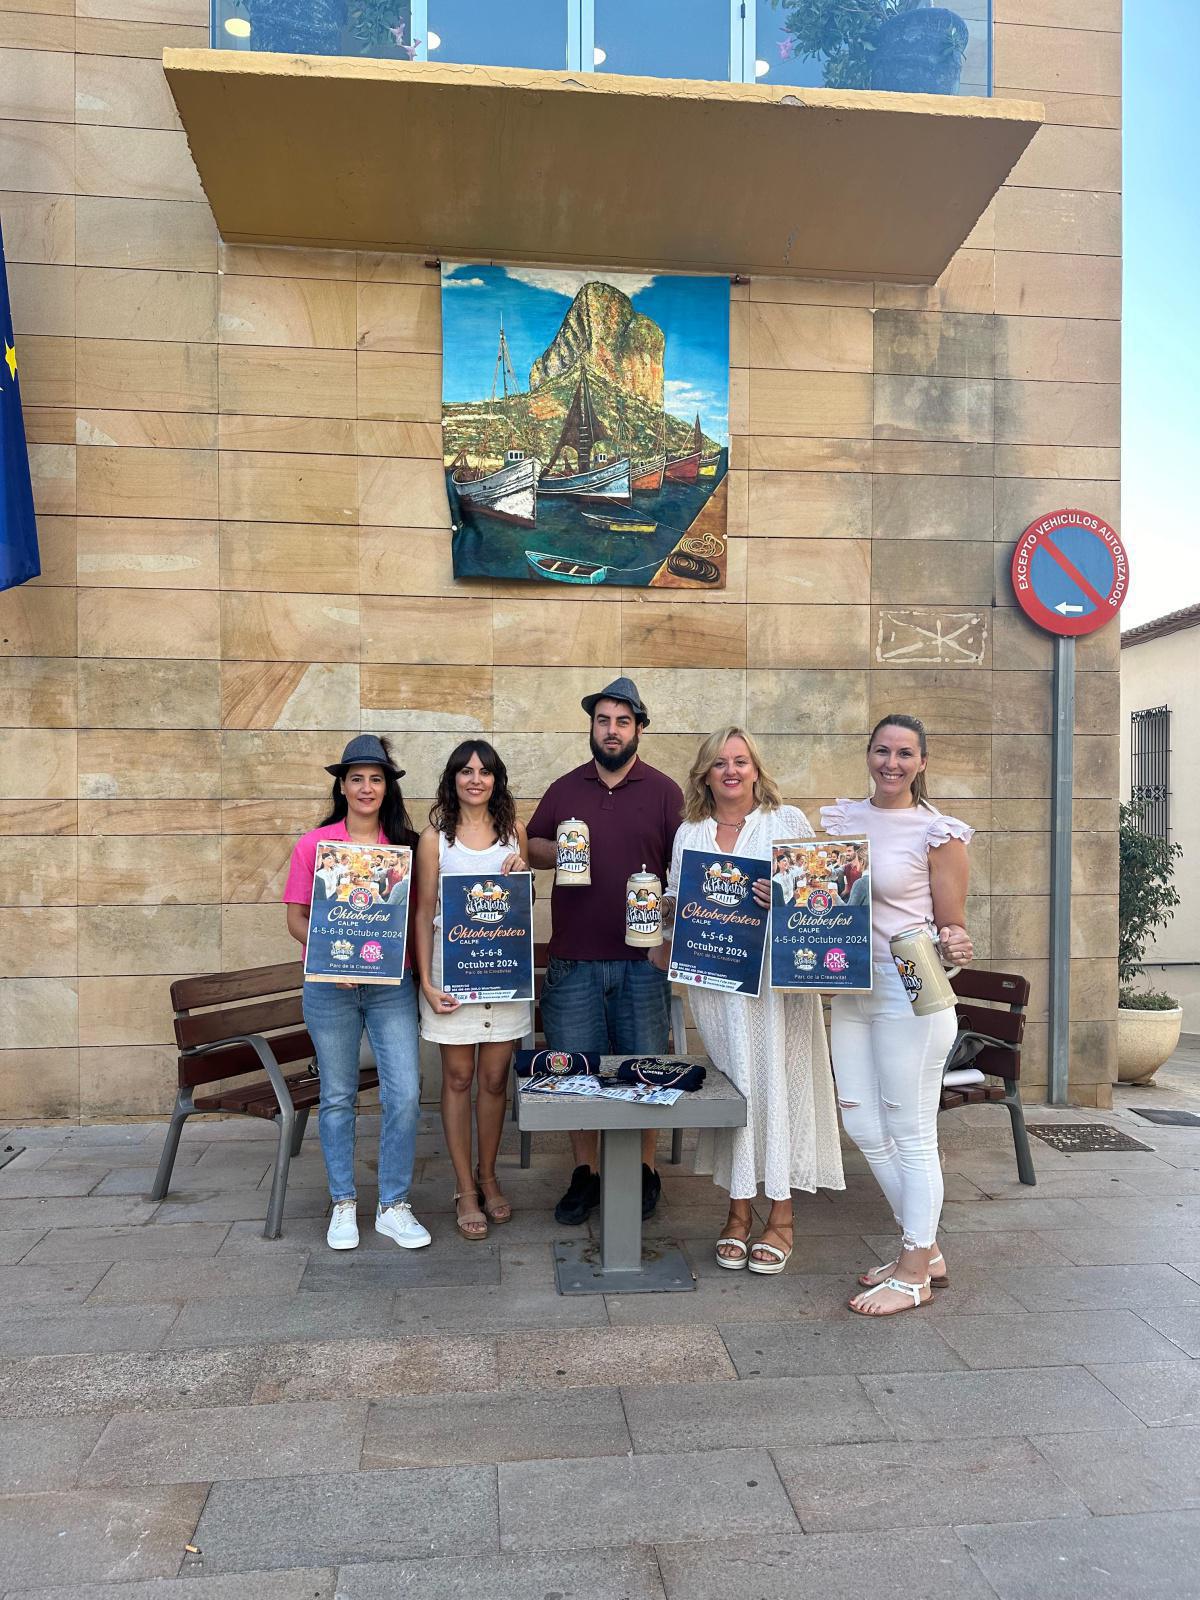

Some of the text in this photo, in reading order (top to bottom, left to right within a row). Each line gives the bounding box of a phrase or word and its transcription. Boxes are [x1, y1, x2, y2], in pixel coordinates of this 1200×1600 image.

[1018, 514, 1125, 606] EXCEPTO VEHICULOS AUTORIZADOS
[328, 906, 390, 924] Oktoberfest
[682, 902, 760, 926] Oktoberfesters
[788, 912, 853, 929] Oktoberfest
[312, 927, 344, 935] 4-5-6-8
[346, 928, 380, 937] Octubre
[448, 924, 525, 942] Oktoberfesters
[701, 931, 733, 942] 4-5-6-8
[364, 944, 382, 954] PRE
[471, 949, 502, 957] 4-5-6-8
[687, 940, 748, 957] Octubre 2024
[458, 961, 494, 969] Octubre
[827, 953, 846, 963] PRE
